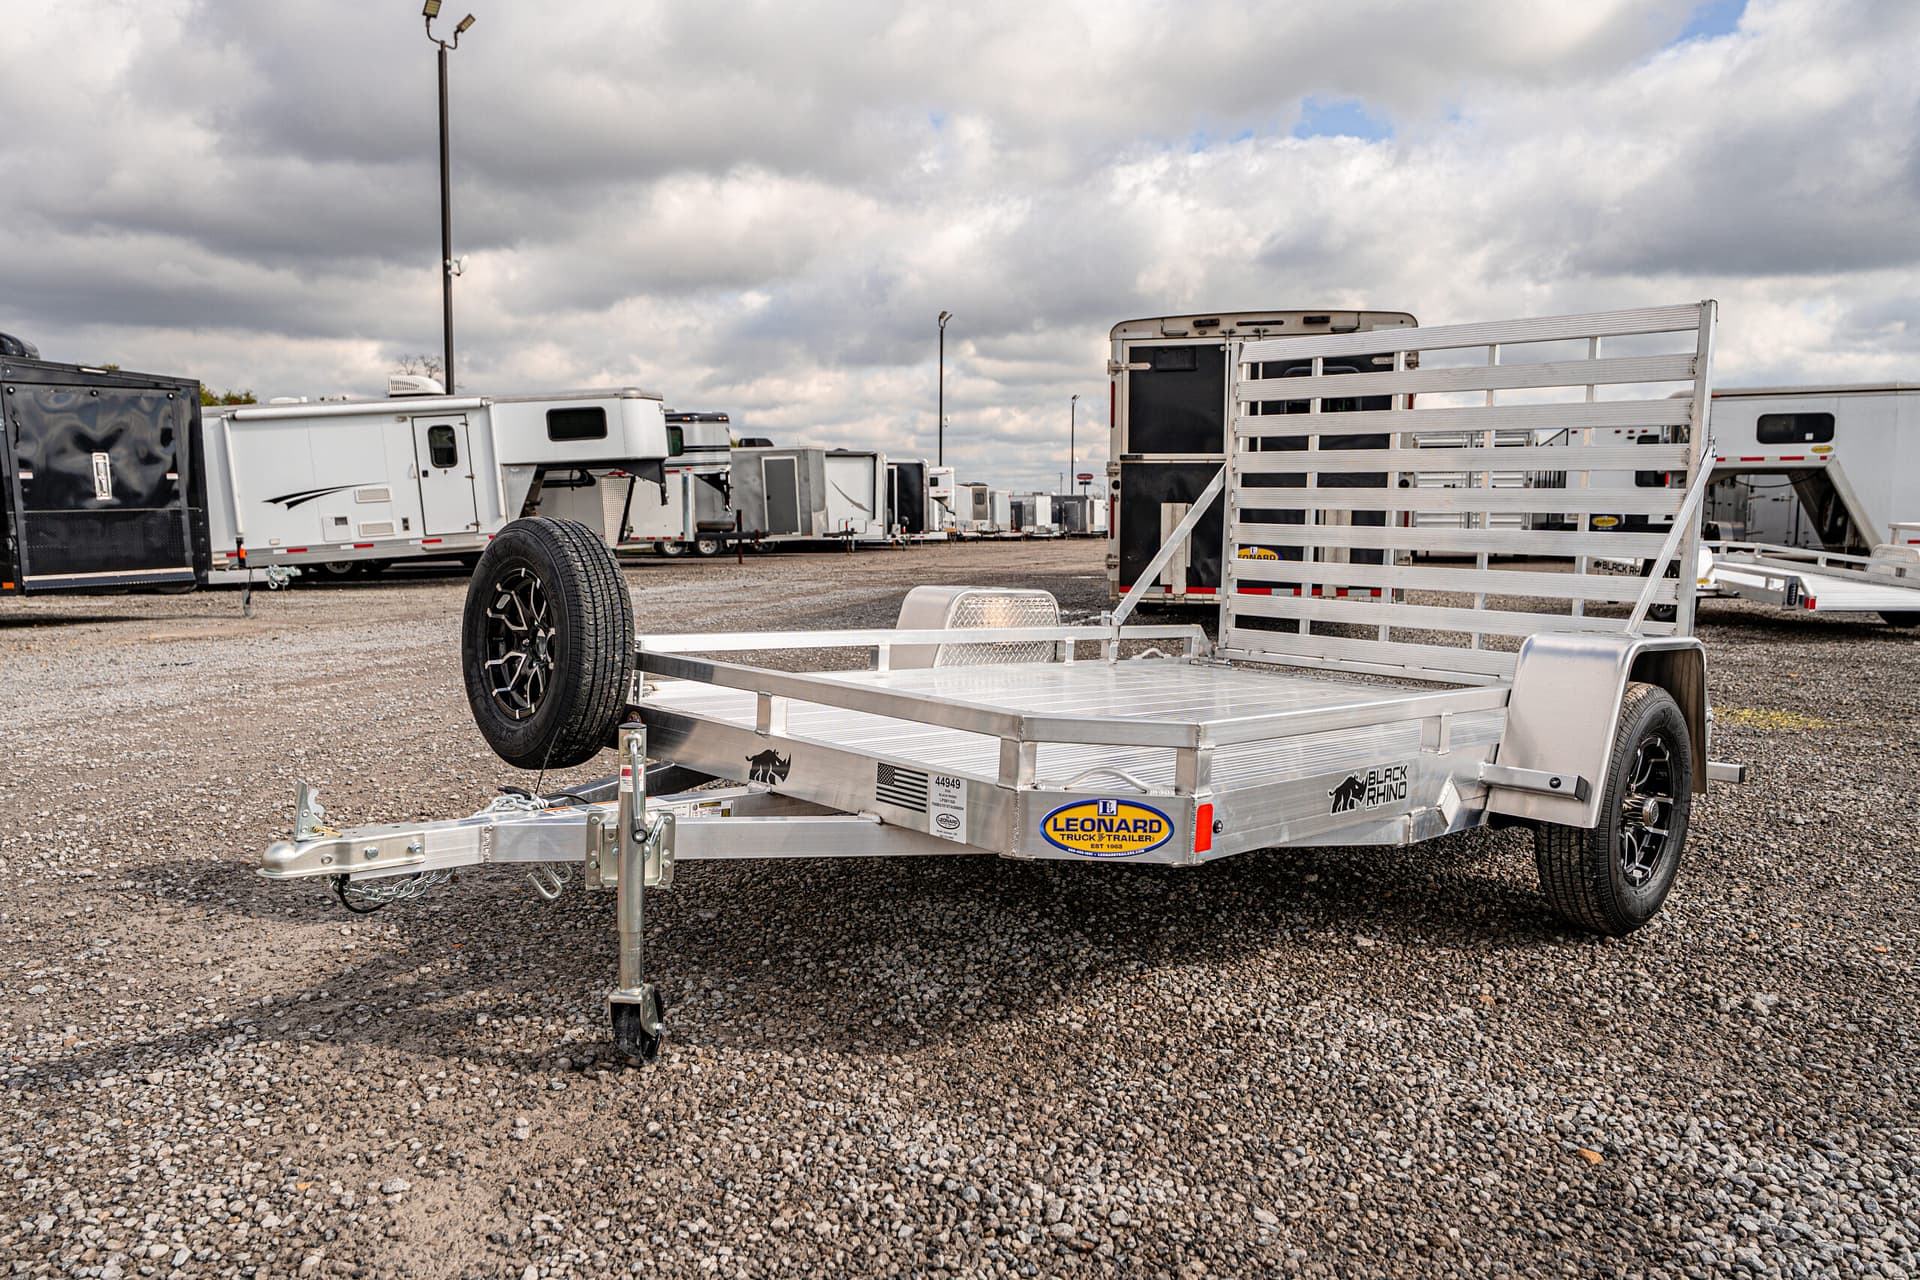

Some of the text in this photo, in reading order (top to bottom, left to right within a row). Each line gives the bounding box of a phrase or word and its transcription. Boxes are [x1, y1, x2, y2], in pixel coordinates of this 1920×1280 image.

[1602, 560, 1628, 573] BLACK
[935, 776, 961, 790] 44949
[1368, 765, 1408, 787] BLACK
[1366, 781, 1407, 807] RHINO
[1053, 817, 1163, 833] LEONARD
[1060, 833, 1096, 842] TRUCK
[1106, 834, 1152, 842] TRAILER
